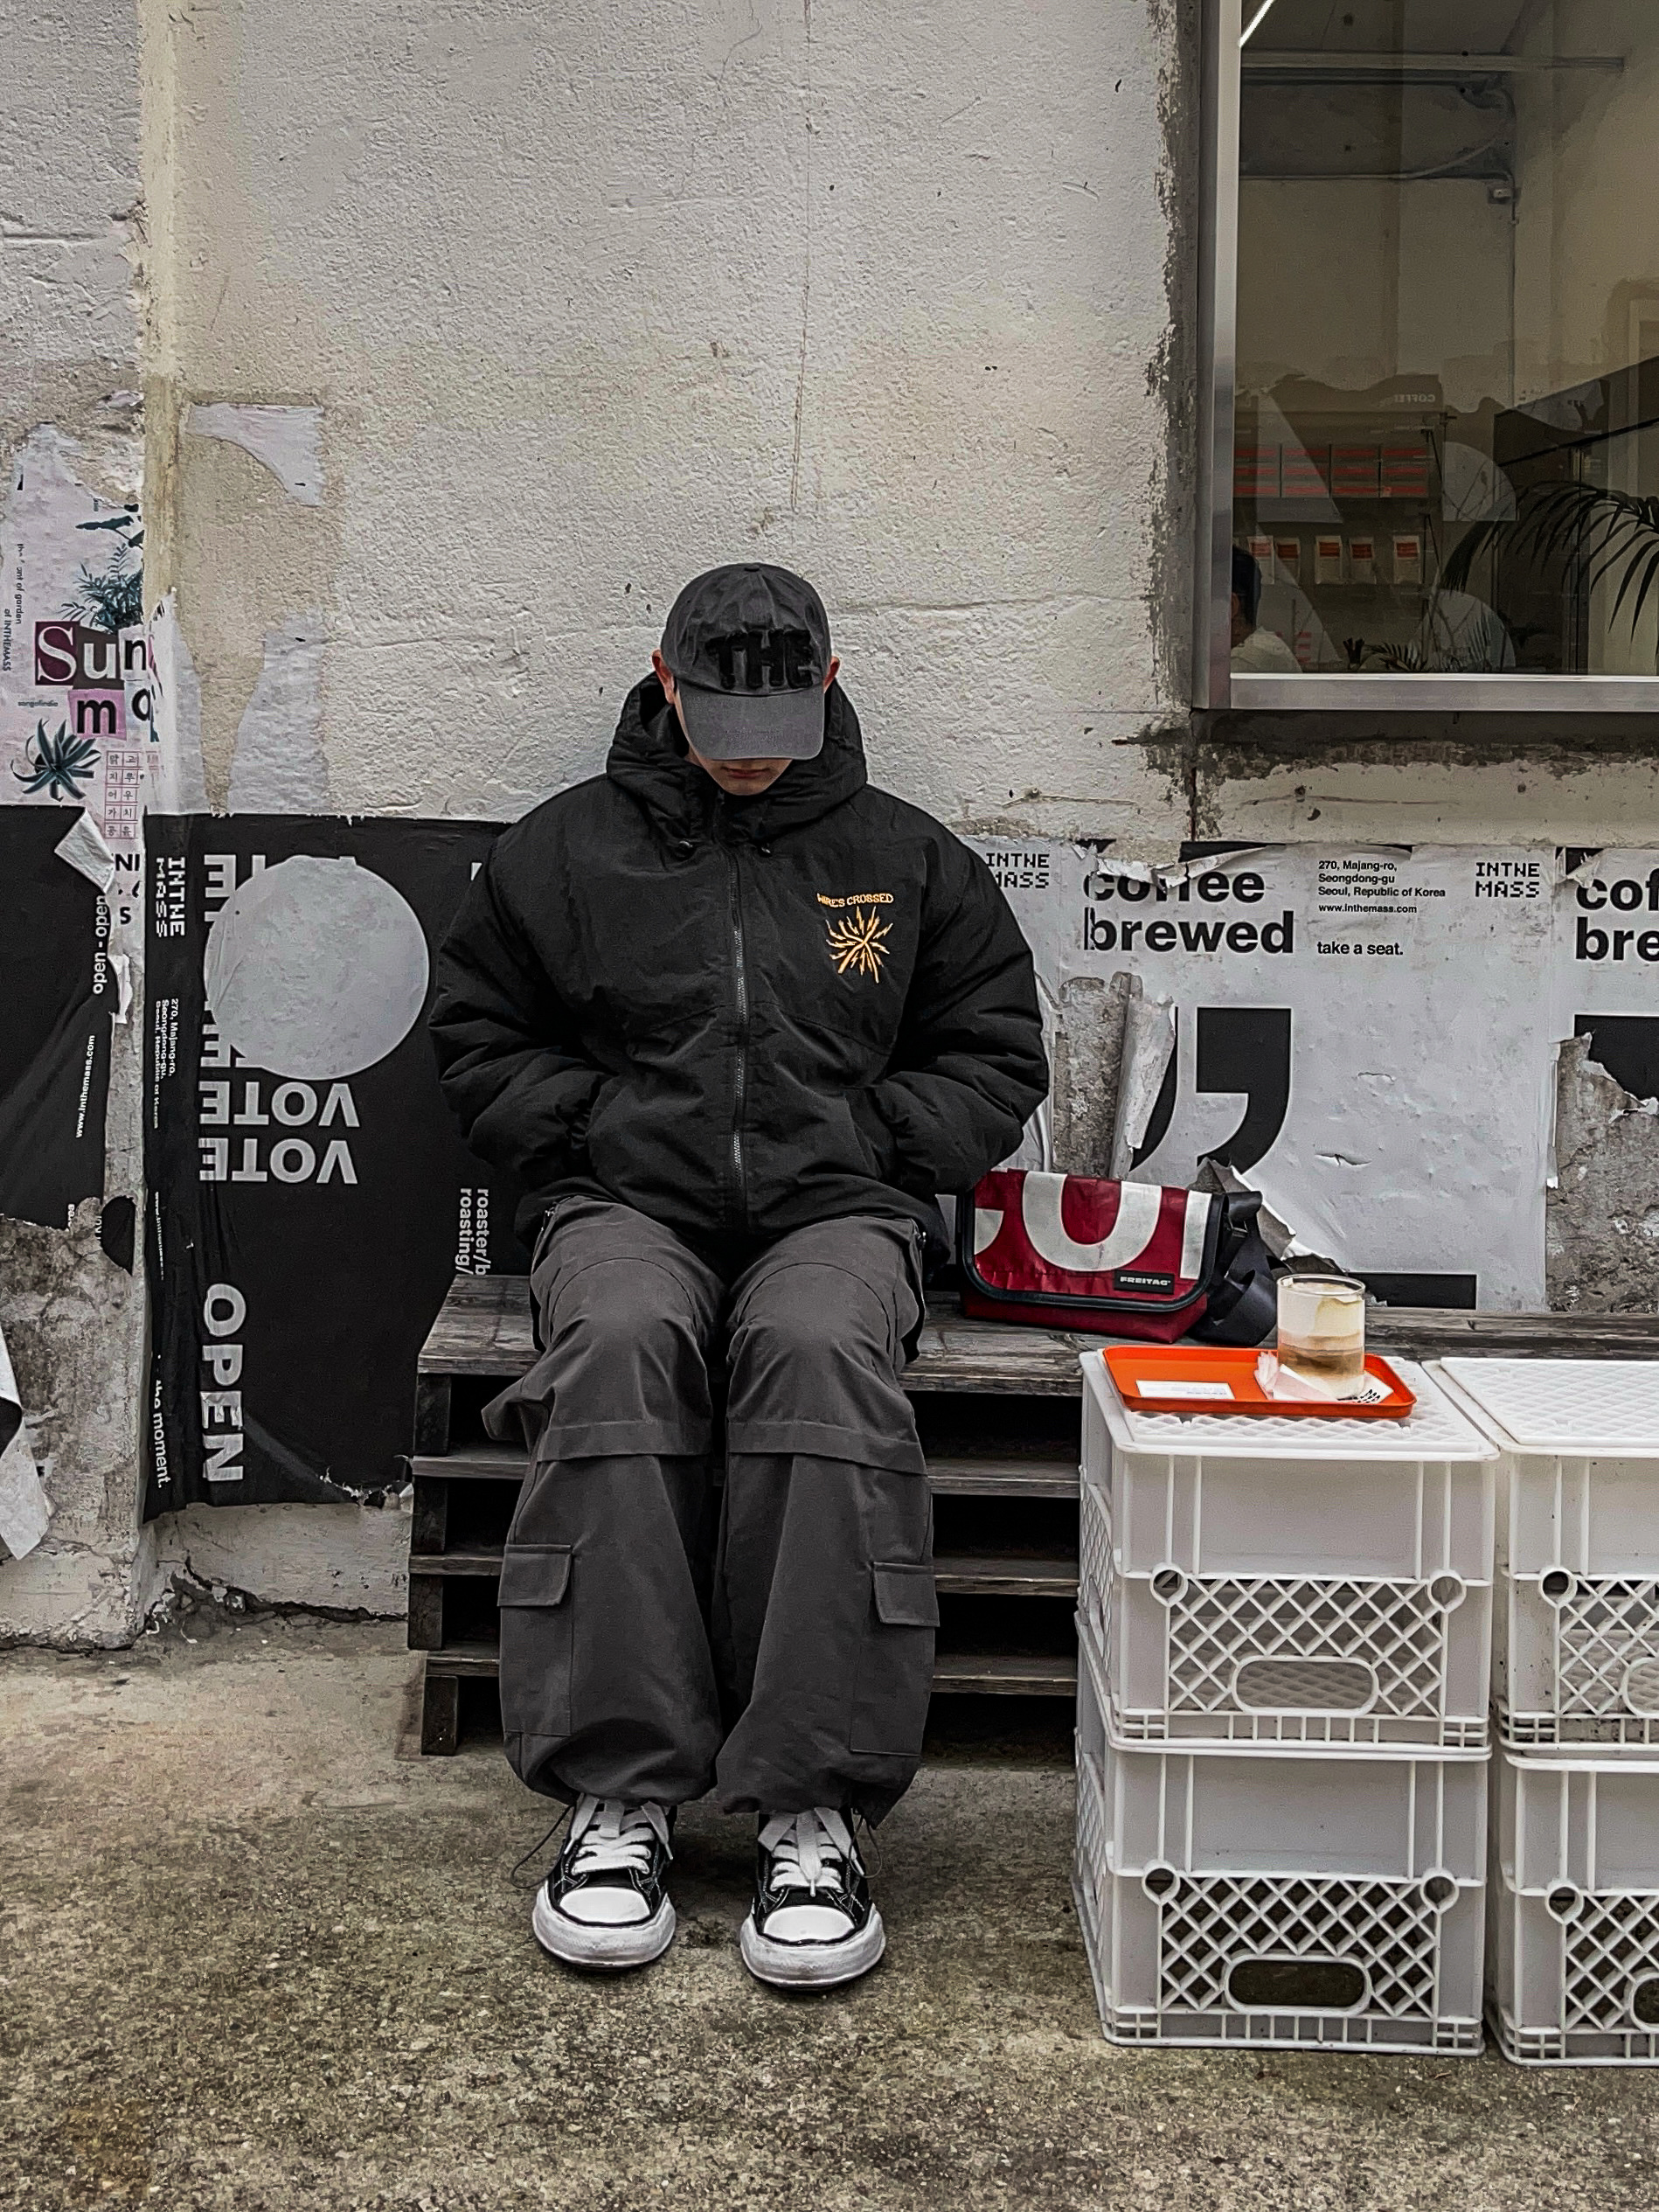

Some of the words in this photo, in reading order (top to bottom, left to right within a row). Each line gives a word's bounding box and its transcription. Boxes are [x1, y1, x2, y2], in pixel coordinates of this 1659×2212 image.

[705, 629, 814, 690] THE
[1318, 860, 1340, 872] 270,
[1343, 860, 1398, 873] Majang-ro,
[1318, 873, 1395, 885] Seongdong-gu
[846, 893, 894, 907] CROSSED
[1318, 886, 1350, 897] Seoul,
[1354, 887, 1399, 898] Republic
[1401, 887, 1413, 897] of
[1415, 887, 1446, 897] Korea
[1318, 903, 1418, 914] www.inthemass.com
[1475, 880, 1540, 898] MASS
[94, 895, 109, 938] open
[1083, 907, 1295, 954] brewed
[1317, 941, 1350, 955] take
[1353, 944, 1363, 955] a
[1366, 943, 1404, 956] seat.
[94, 950, 107, 995] open
[76, 1034, 95, 1138] www.inthemass.com
[199, 1081, 360, 1128] VOTE
[198, 1137, 358, 1185] VOTE
[1120, 1276, 1170, 1286] FREITAG
[199, 1283, 246, 1482] OPEN
[153, 1412, 172, 1489] moment.
